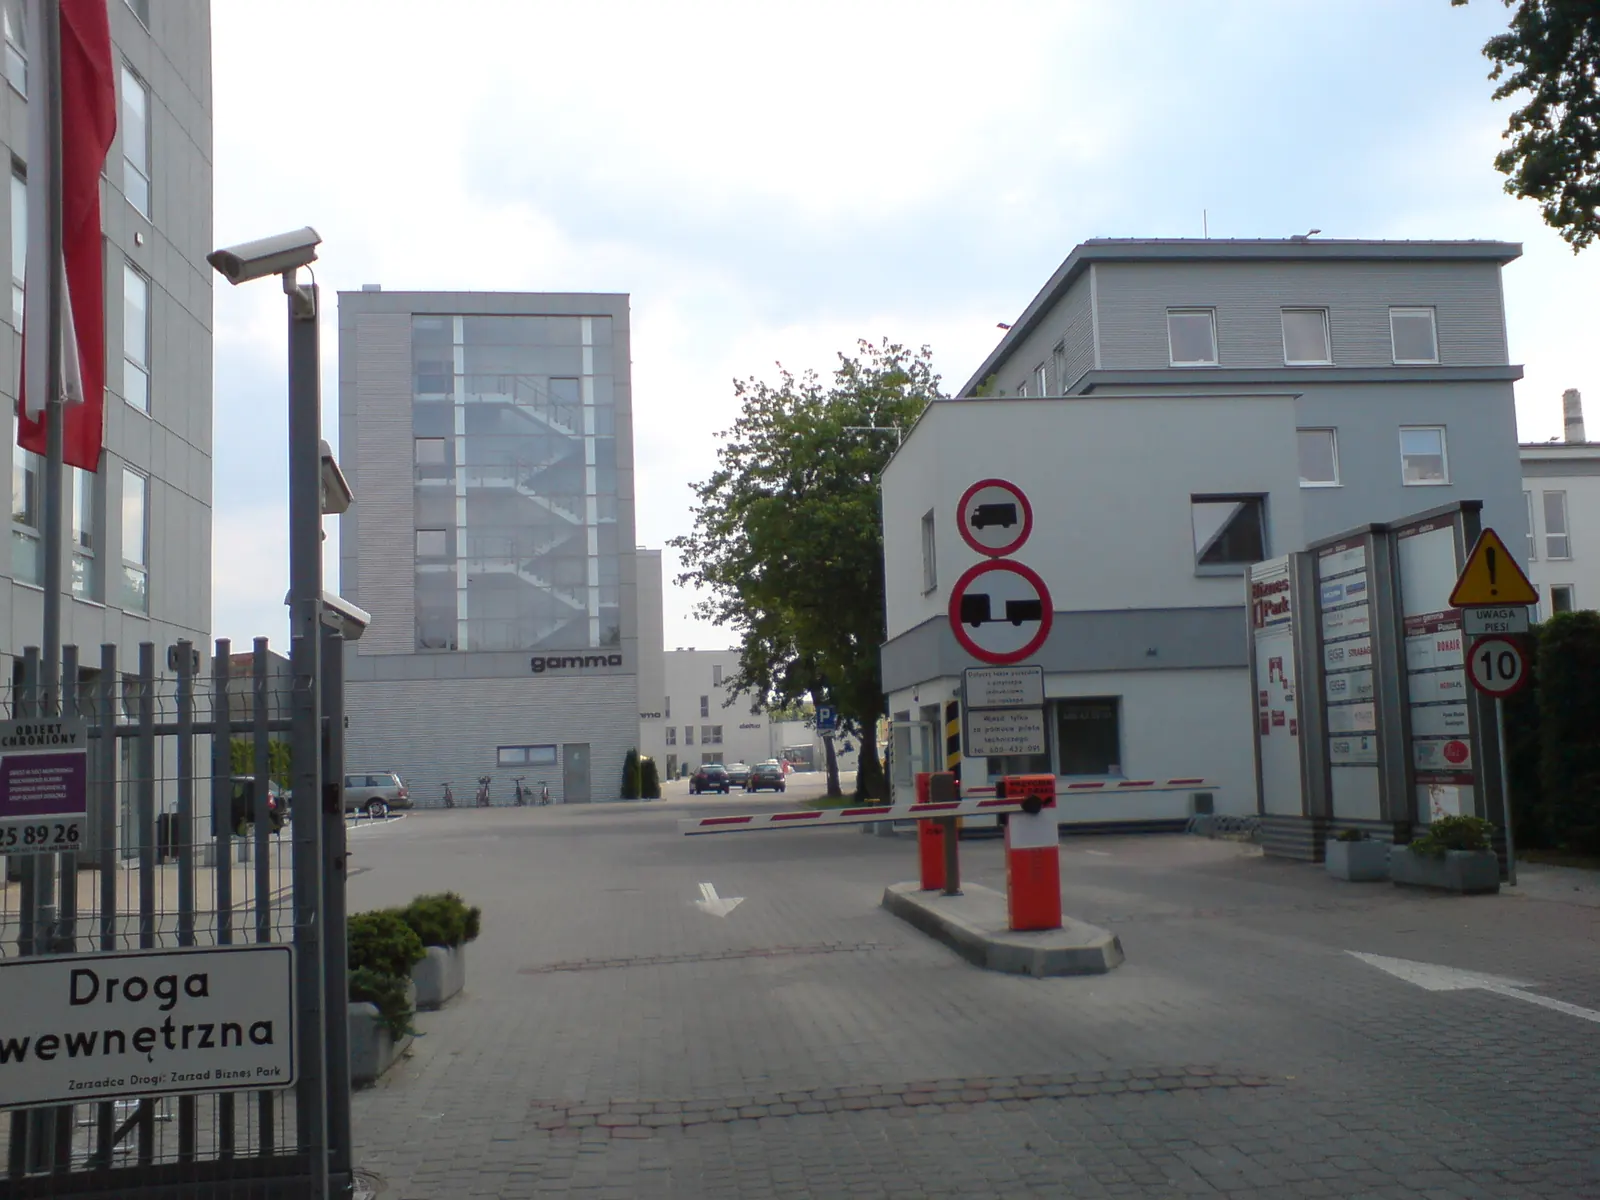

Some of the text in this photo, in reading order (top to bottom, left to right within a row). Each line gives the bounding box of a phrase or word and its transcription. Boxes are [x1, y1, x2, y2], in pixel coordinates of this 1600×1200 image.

[1263, 596, 1290, 616] Park
[1476, 609, 1516, 619] UWAGA
[1484, 622, 1509, 632] PIESI
[530, 654, 622, 673] gamma
[1481, 650, 1516, 681] 10
[819, 708, 830, 723] P
[15, 723, 62, 736] OBIEKT
[1, 733, 77, 747] CHRONIONY
[23, 825, 49, 846] 89
[53, 823, 80, 844] 26
[69, 968, 210, 1011] Droga
[0, 1015, 275, 1064] wewnętrzna
[215, 1068, 252, 1079] Biznes
[256, 1065, 282, 1078] Park
